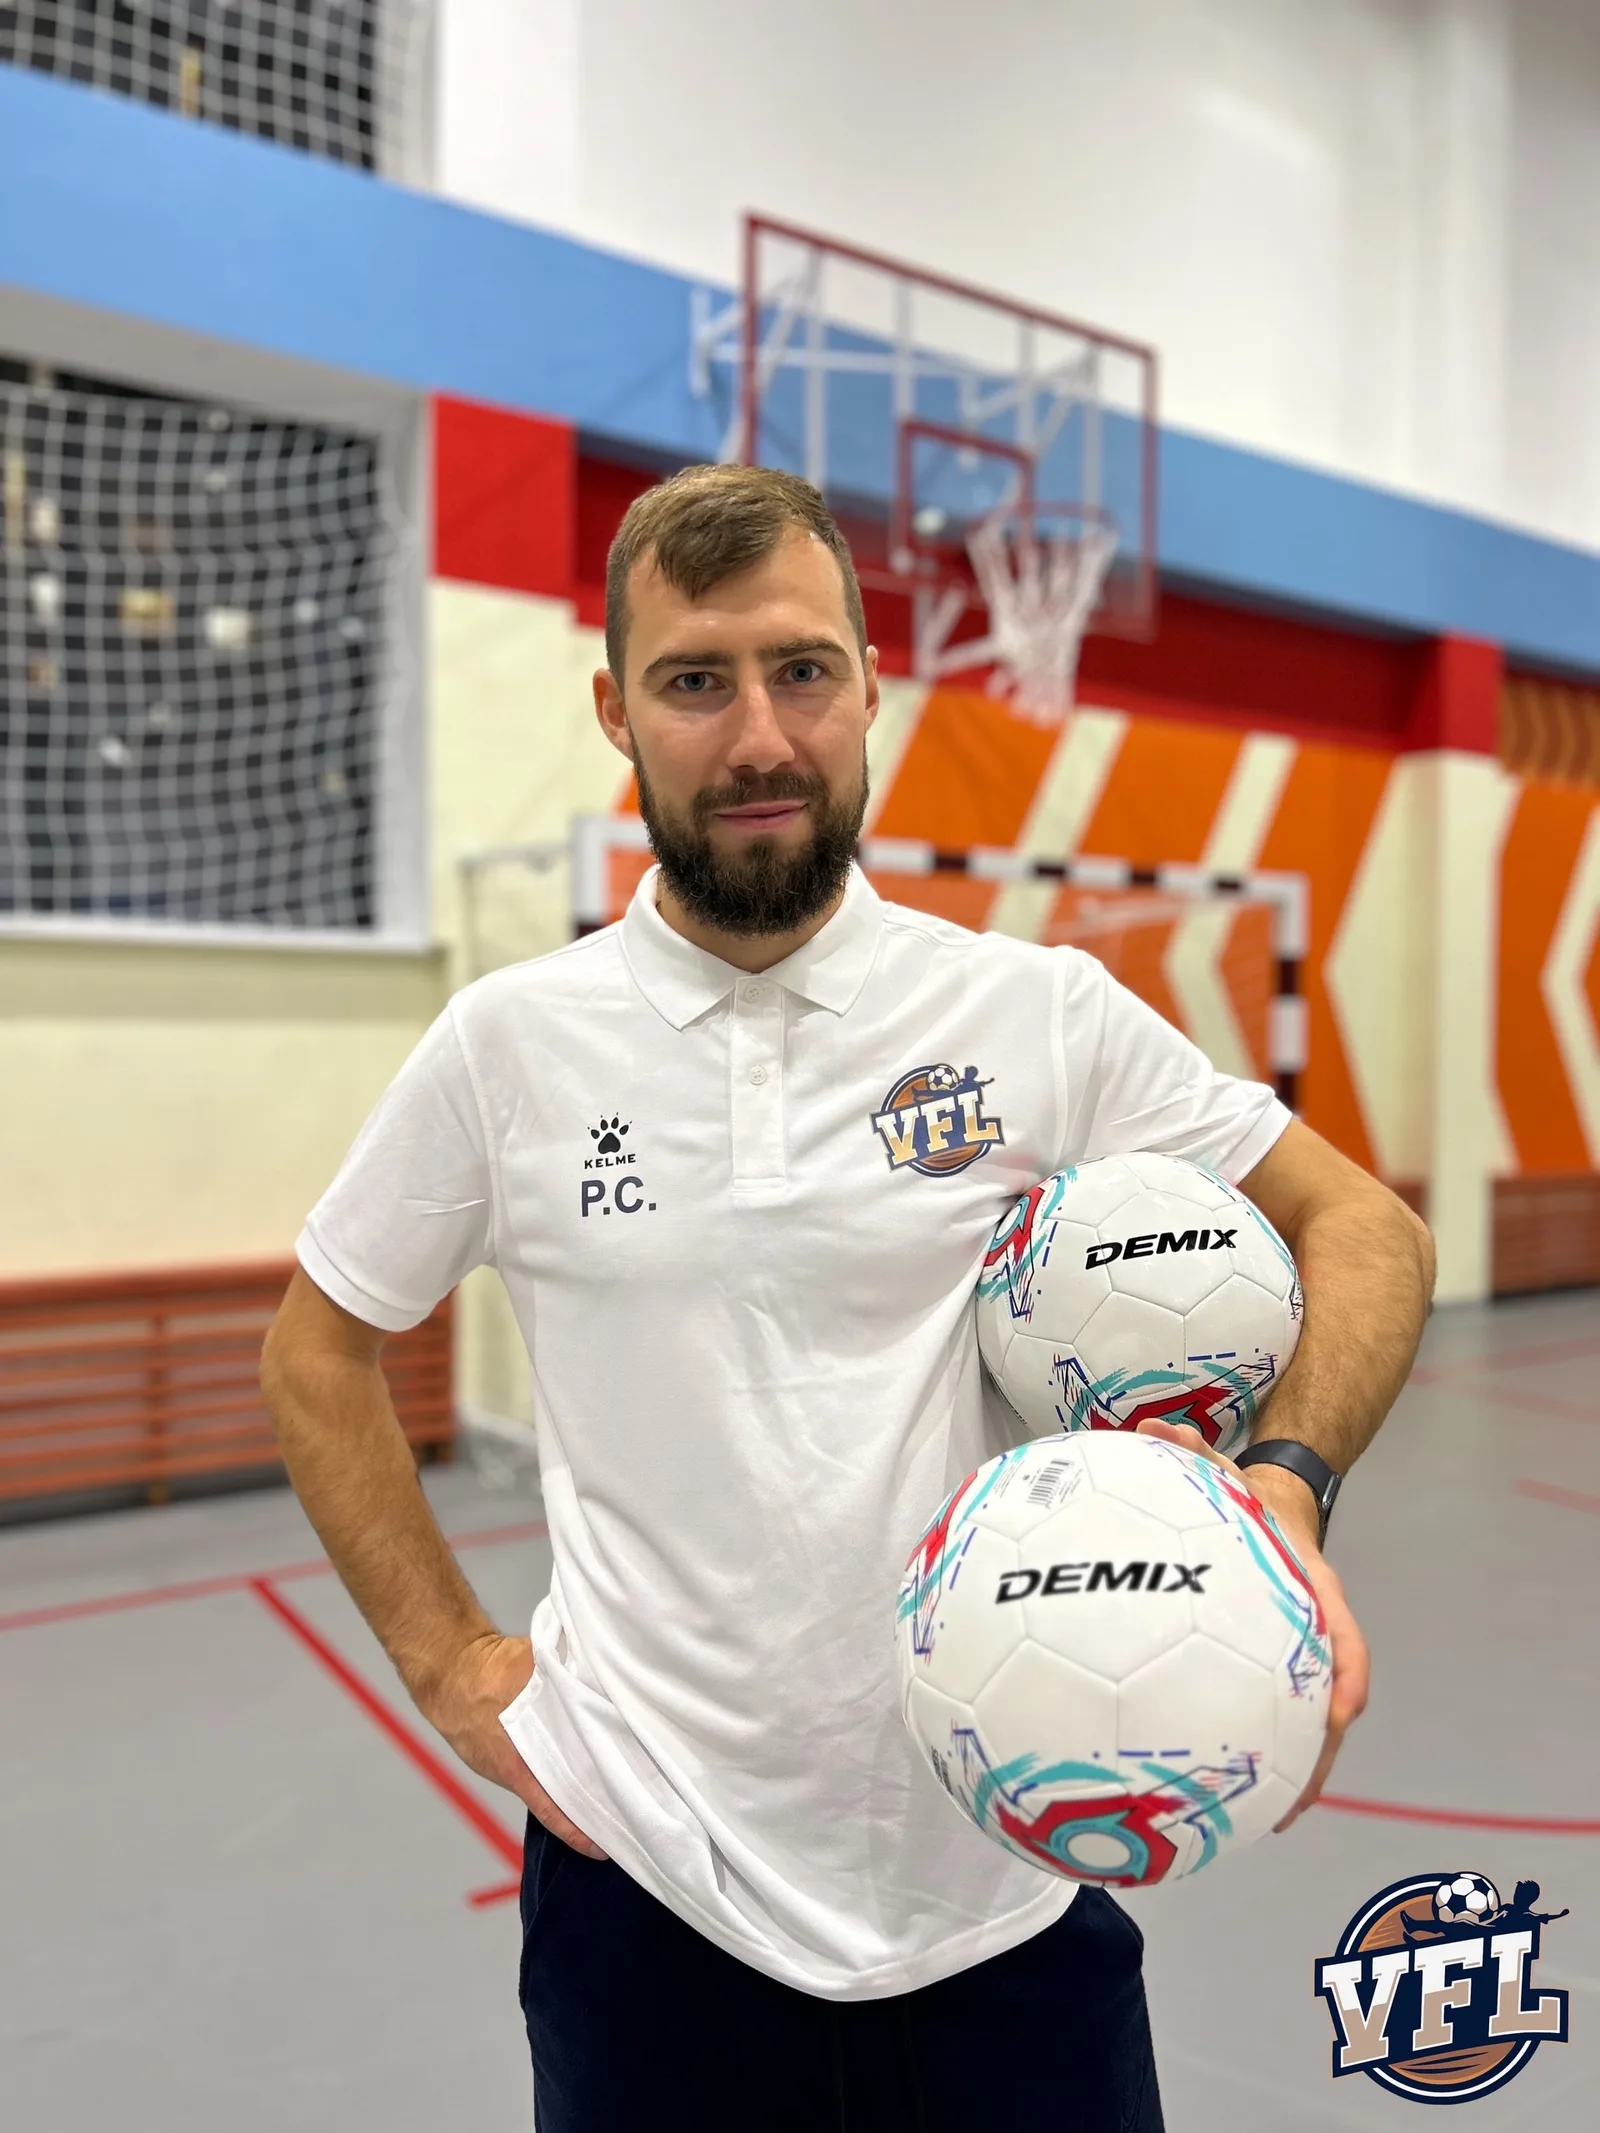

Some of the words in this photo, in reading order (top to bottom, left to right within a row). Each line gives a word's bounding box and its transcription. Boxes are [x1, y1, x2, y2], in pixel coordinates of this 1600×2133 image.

[875, 1090, 999, 1165] VFL
[584, 1153, 637, 1170] KELME
[1085, 1228, 1239, 1270] DEMIX
[995, 1560, 1213, 1605] DEMIX
